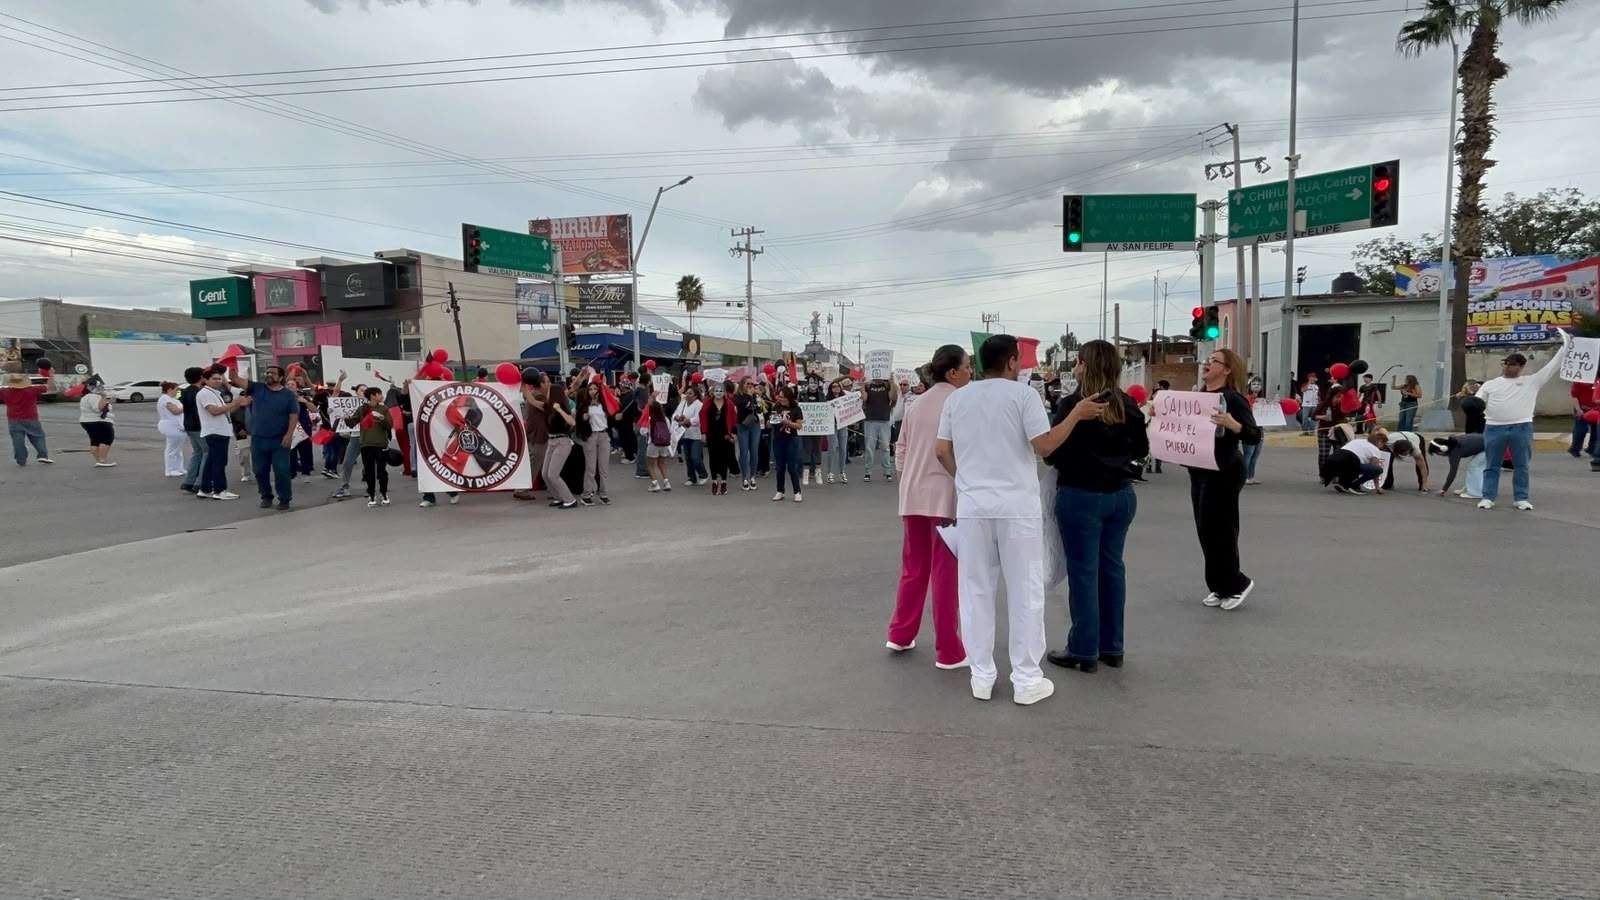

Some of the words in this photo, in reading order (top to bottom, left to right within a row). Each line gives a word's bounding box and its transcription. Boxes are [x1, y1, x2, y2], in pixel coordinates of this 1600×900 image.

[1248, 182, 1321, 201] CHIHUHUA
[1324, 174, 1367, 189] Centro
[1267, 193, 1338, 212] MIADOR
[551, 216, 608, 239] BIRRIA
[1301, 224, 1341, 237] FELIPE
[1122, 243, 1141, 251] SAN
[1143, 242, 1175, 250] FELIPE
[487, 268, 513, 277] VIALIDAD
[521, 271, 545, 280] CANTERA
[1467, 299, 1573, 314] SCRIPCIONES
[1478, 333, 1497, 342] 614
[1499, 333, 1518, 341] 208
[1578, 361, 1594, 371] TU
[420, 395, 439, 424] BASE
[438, 385, 514, 424] TRABAJADORA
[1161, 395, 1202, 417] SALUD
[1160, 422, 1181, 436] PARA
[1186, 425, 1196, 436] EL
[1165, 439, 1196, 455] PUEBLO
[427, 453, 465, 486] UNIDAD
[466, 479, 474, 488] Y
[475, 452, 519, 489] DIGNIDAD
